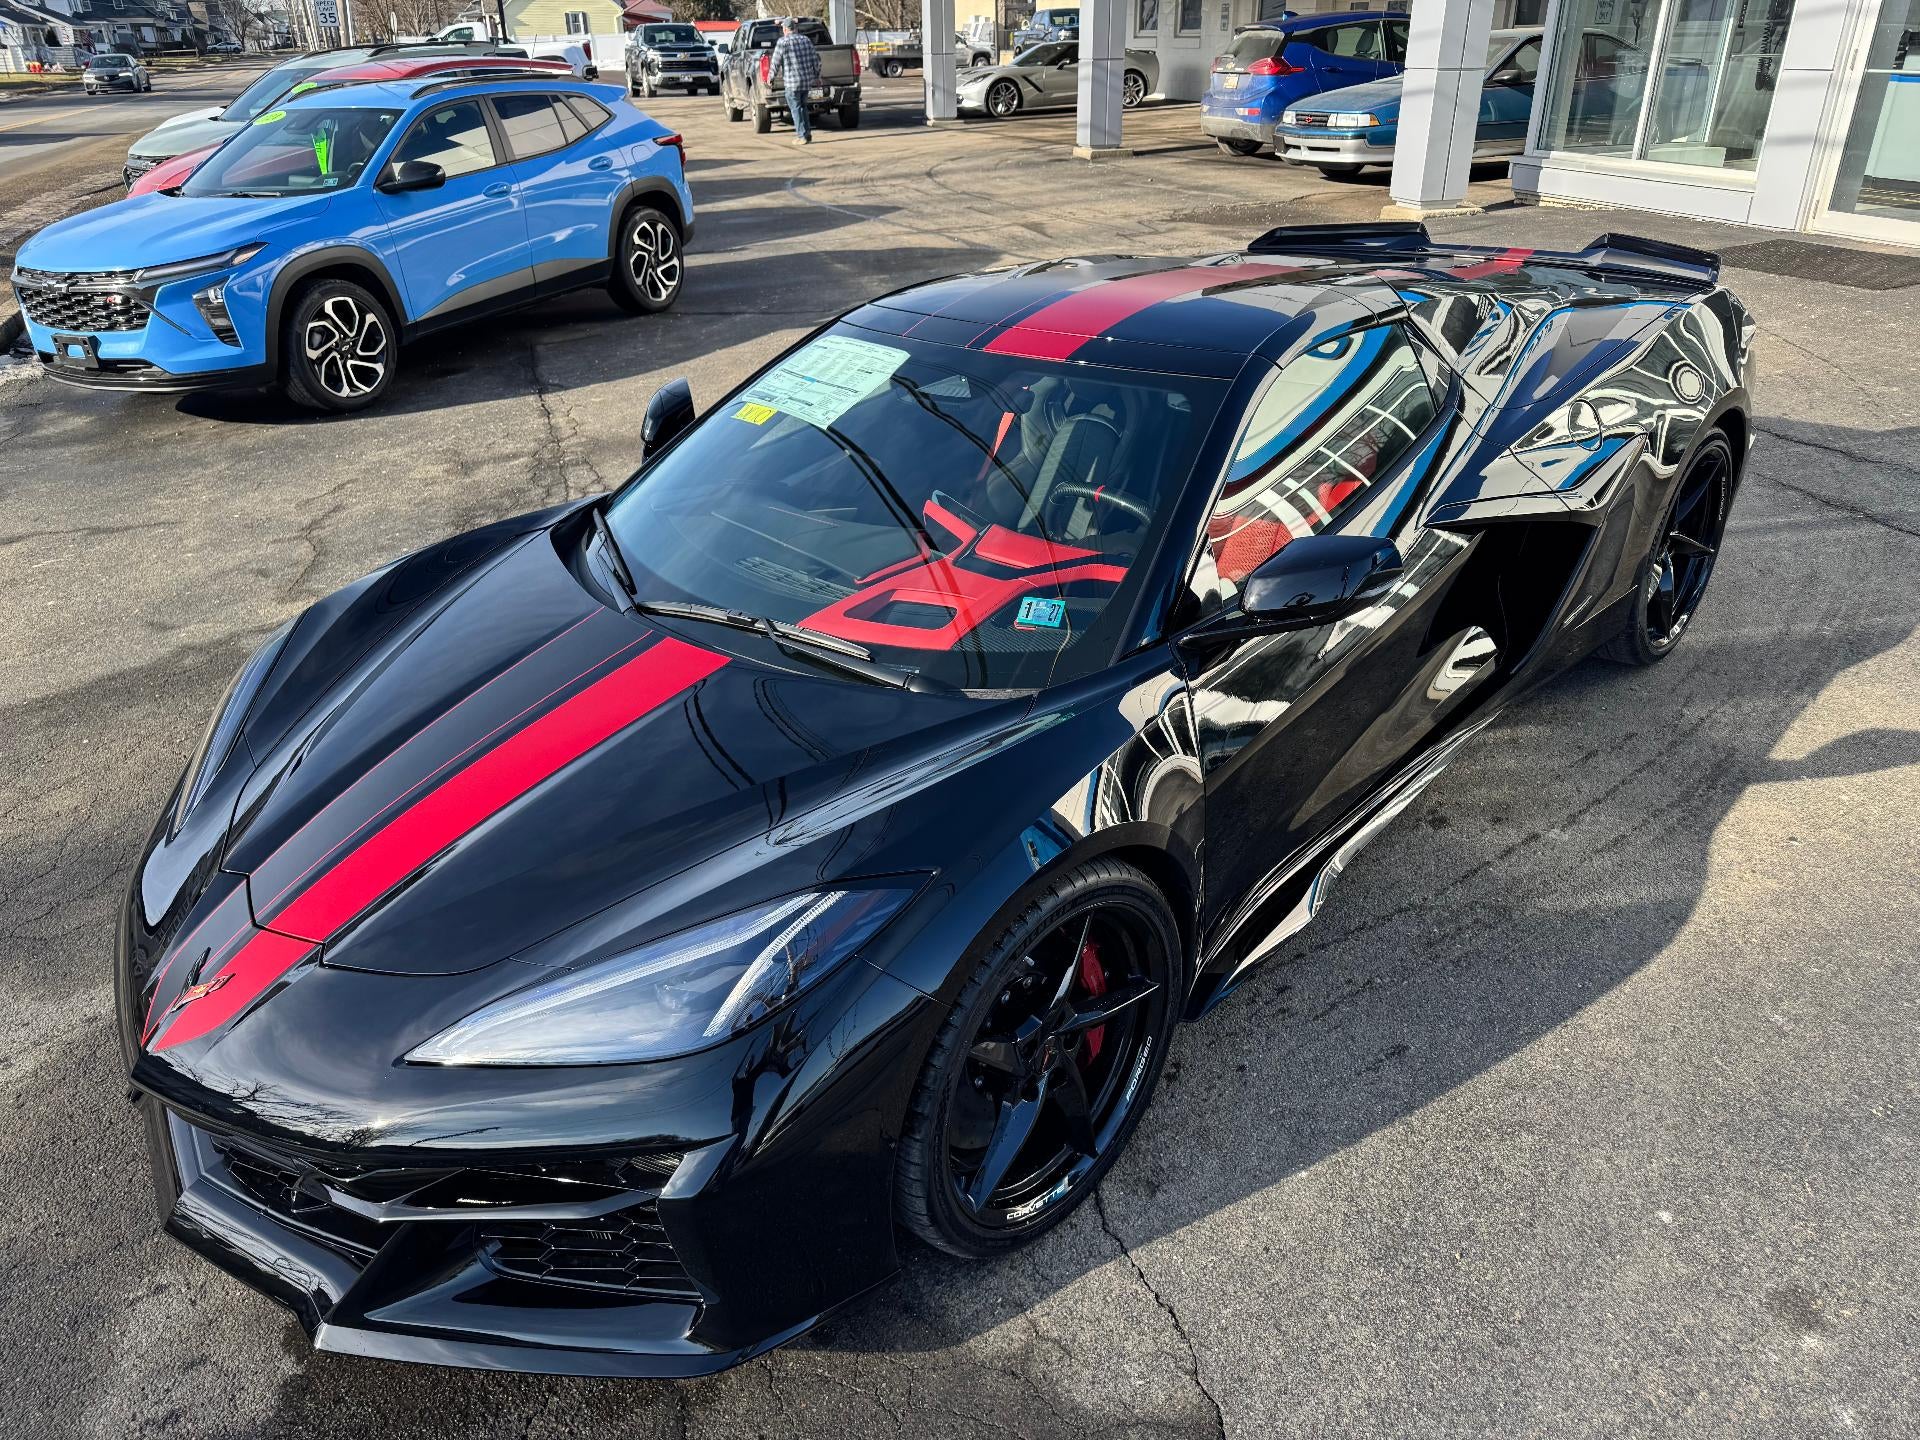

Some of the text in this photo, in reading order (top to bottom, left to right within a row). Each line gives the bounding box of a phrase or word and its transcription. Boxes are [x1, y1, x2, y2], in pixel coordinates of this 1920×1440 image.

[319, 12, 337, 24] 35
[1047, 603, 1062, 623] 27
[1006, 1182, 1066, 1220] CORVETTE
